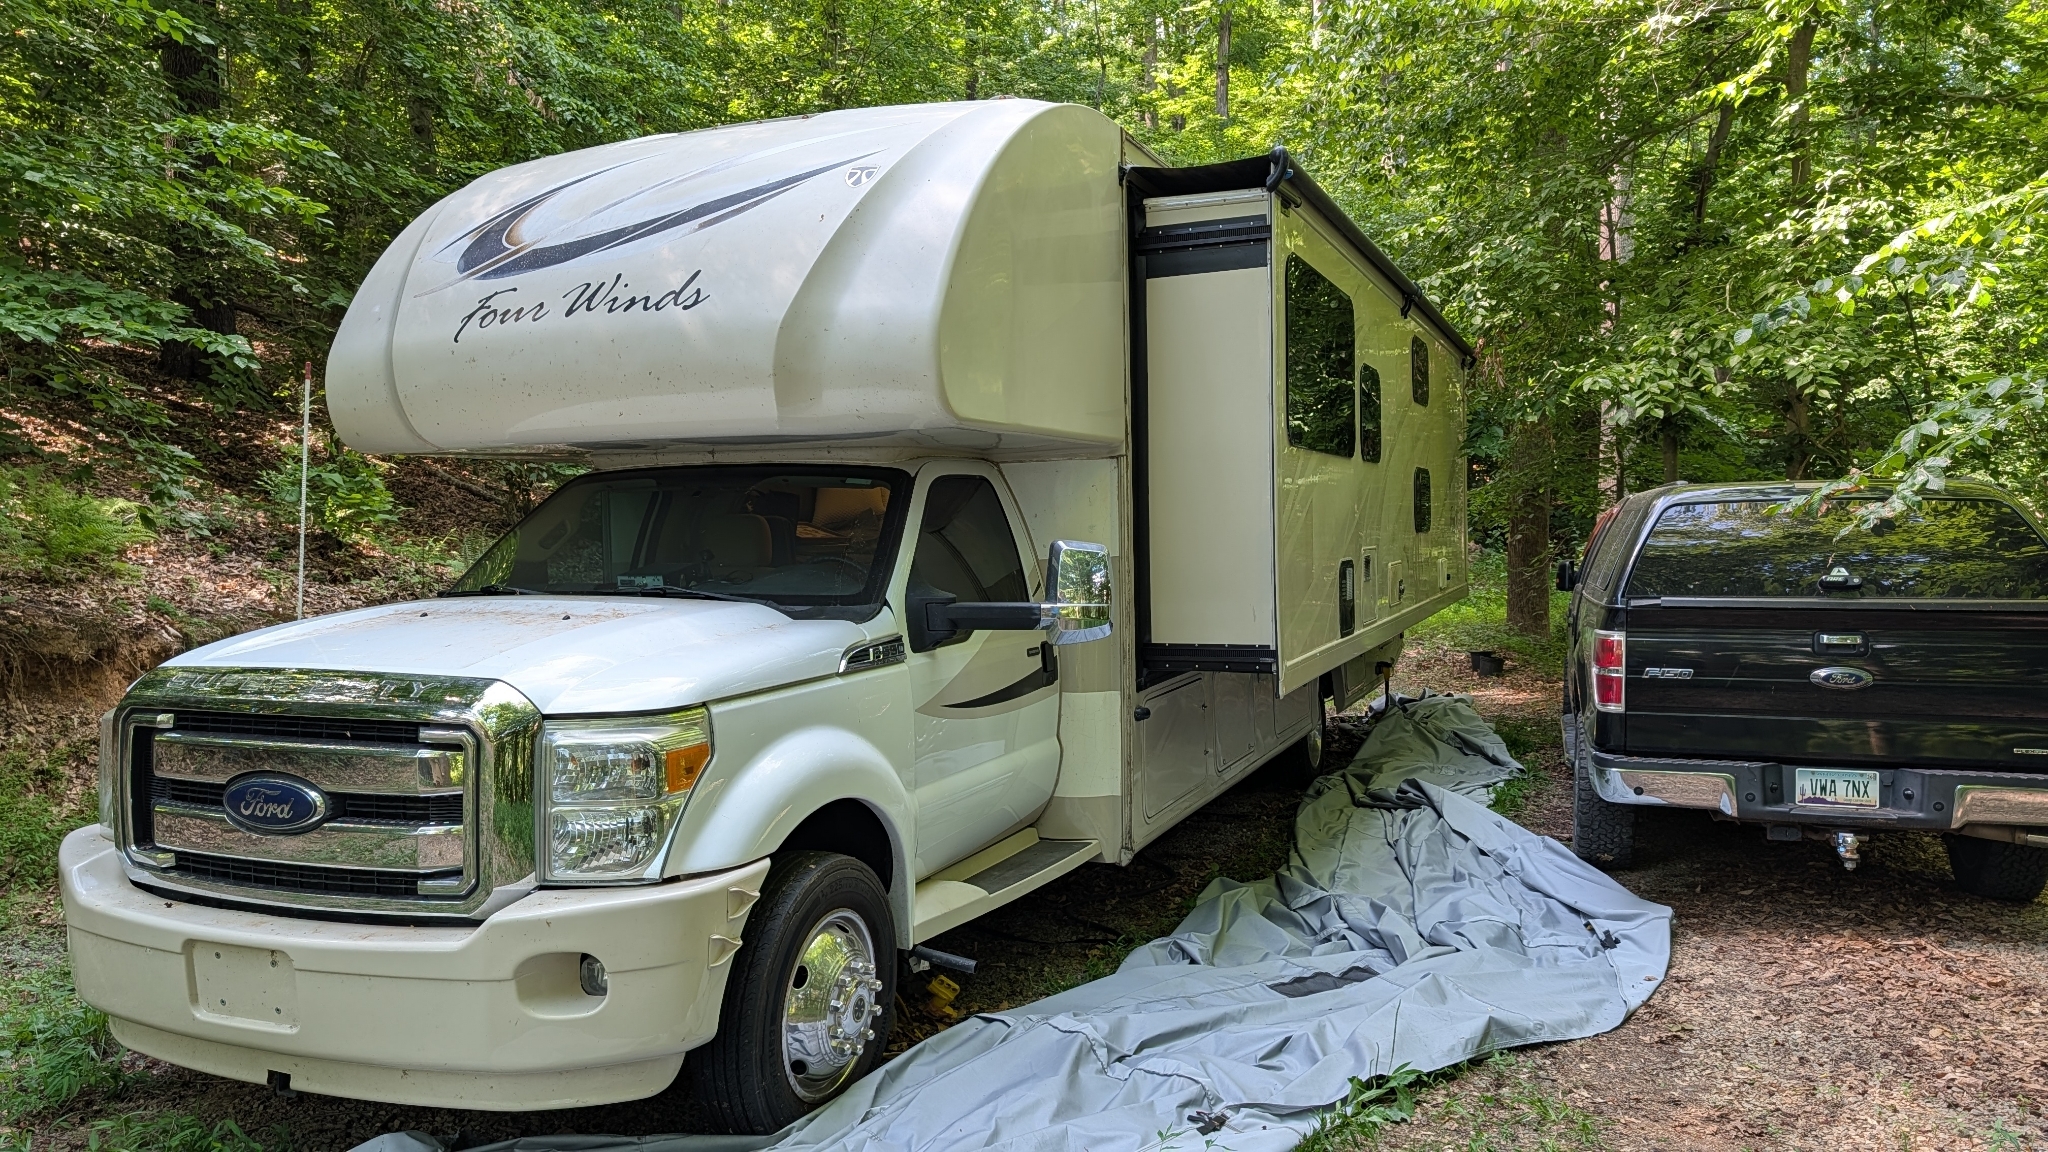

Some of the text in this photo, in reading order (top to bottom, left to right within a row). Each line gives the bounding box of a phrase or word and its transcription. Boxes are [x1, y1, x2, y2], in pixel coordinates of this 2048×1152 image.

[453, 268, 711, 343] Four Winds
[1829, 673, 1856, 684] Ford
[1809, 778, 1870, 799] VWA 7NX
[240, 787, 293, 820] Ford
